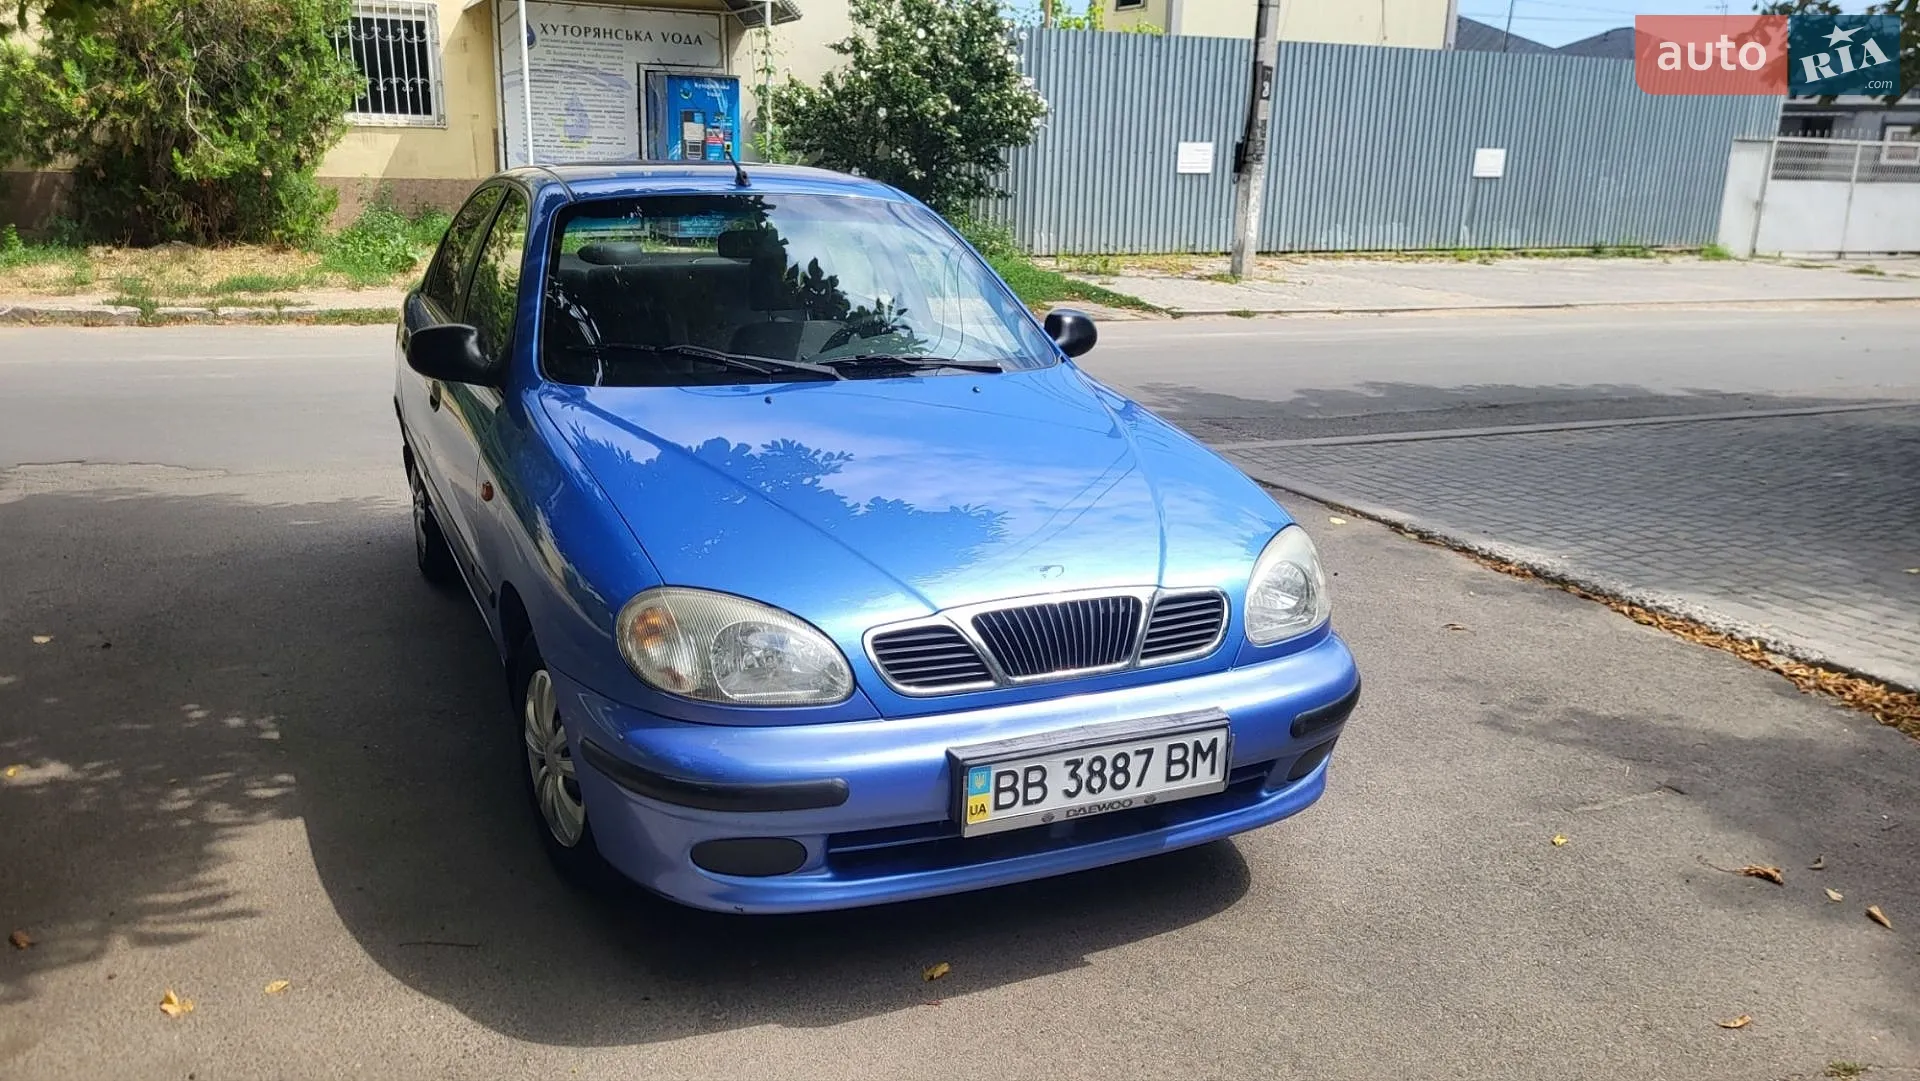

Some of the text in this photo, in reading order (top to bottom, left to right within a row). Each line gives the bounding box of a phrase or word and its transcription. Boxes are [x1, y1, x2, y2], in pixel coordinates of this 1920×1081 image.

[540, 23, 653, 42] ХУТОРЯНСЬКА
[993, 737, 1219, 811] BB 3887 BM
[969, 804, 987, 816] UA
[1065, 798, 1133, 818] DAEWOO
